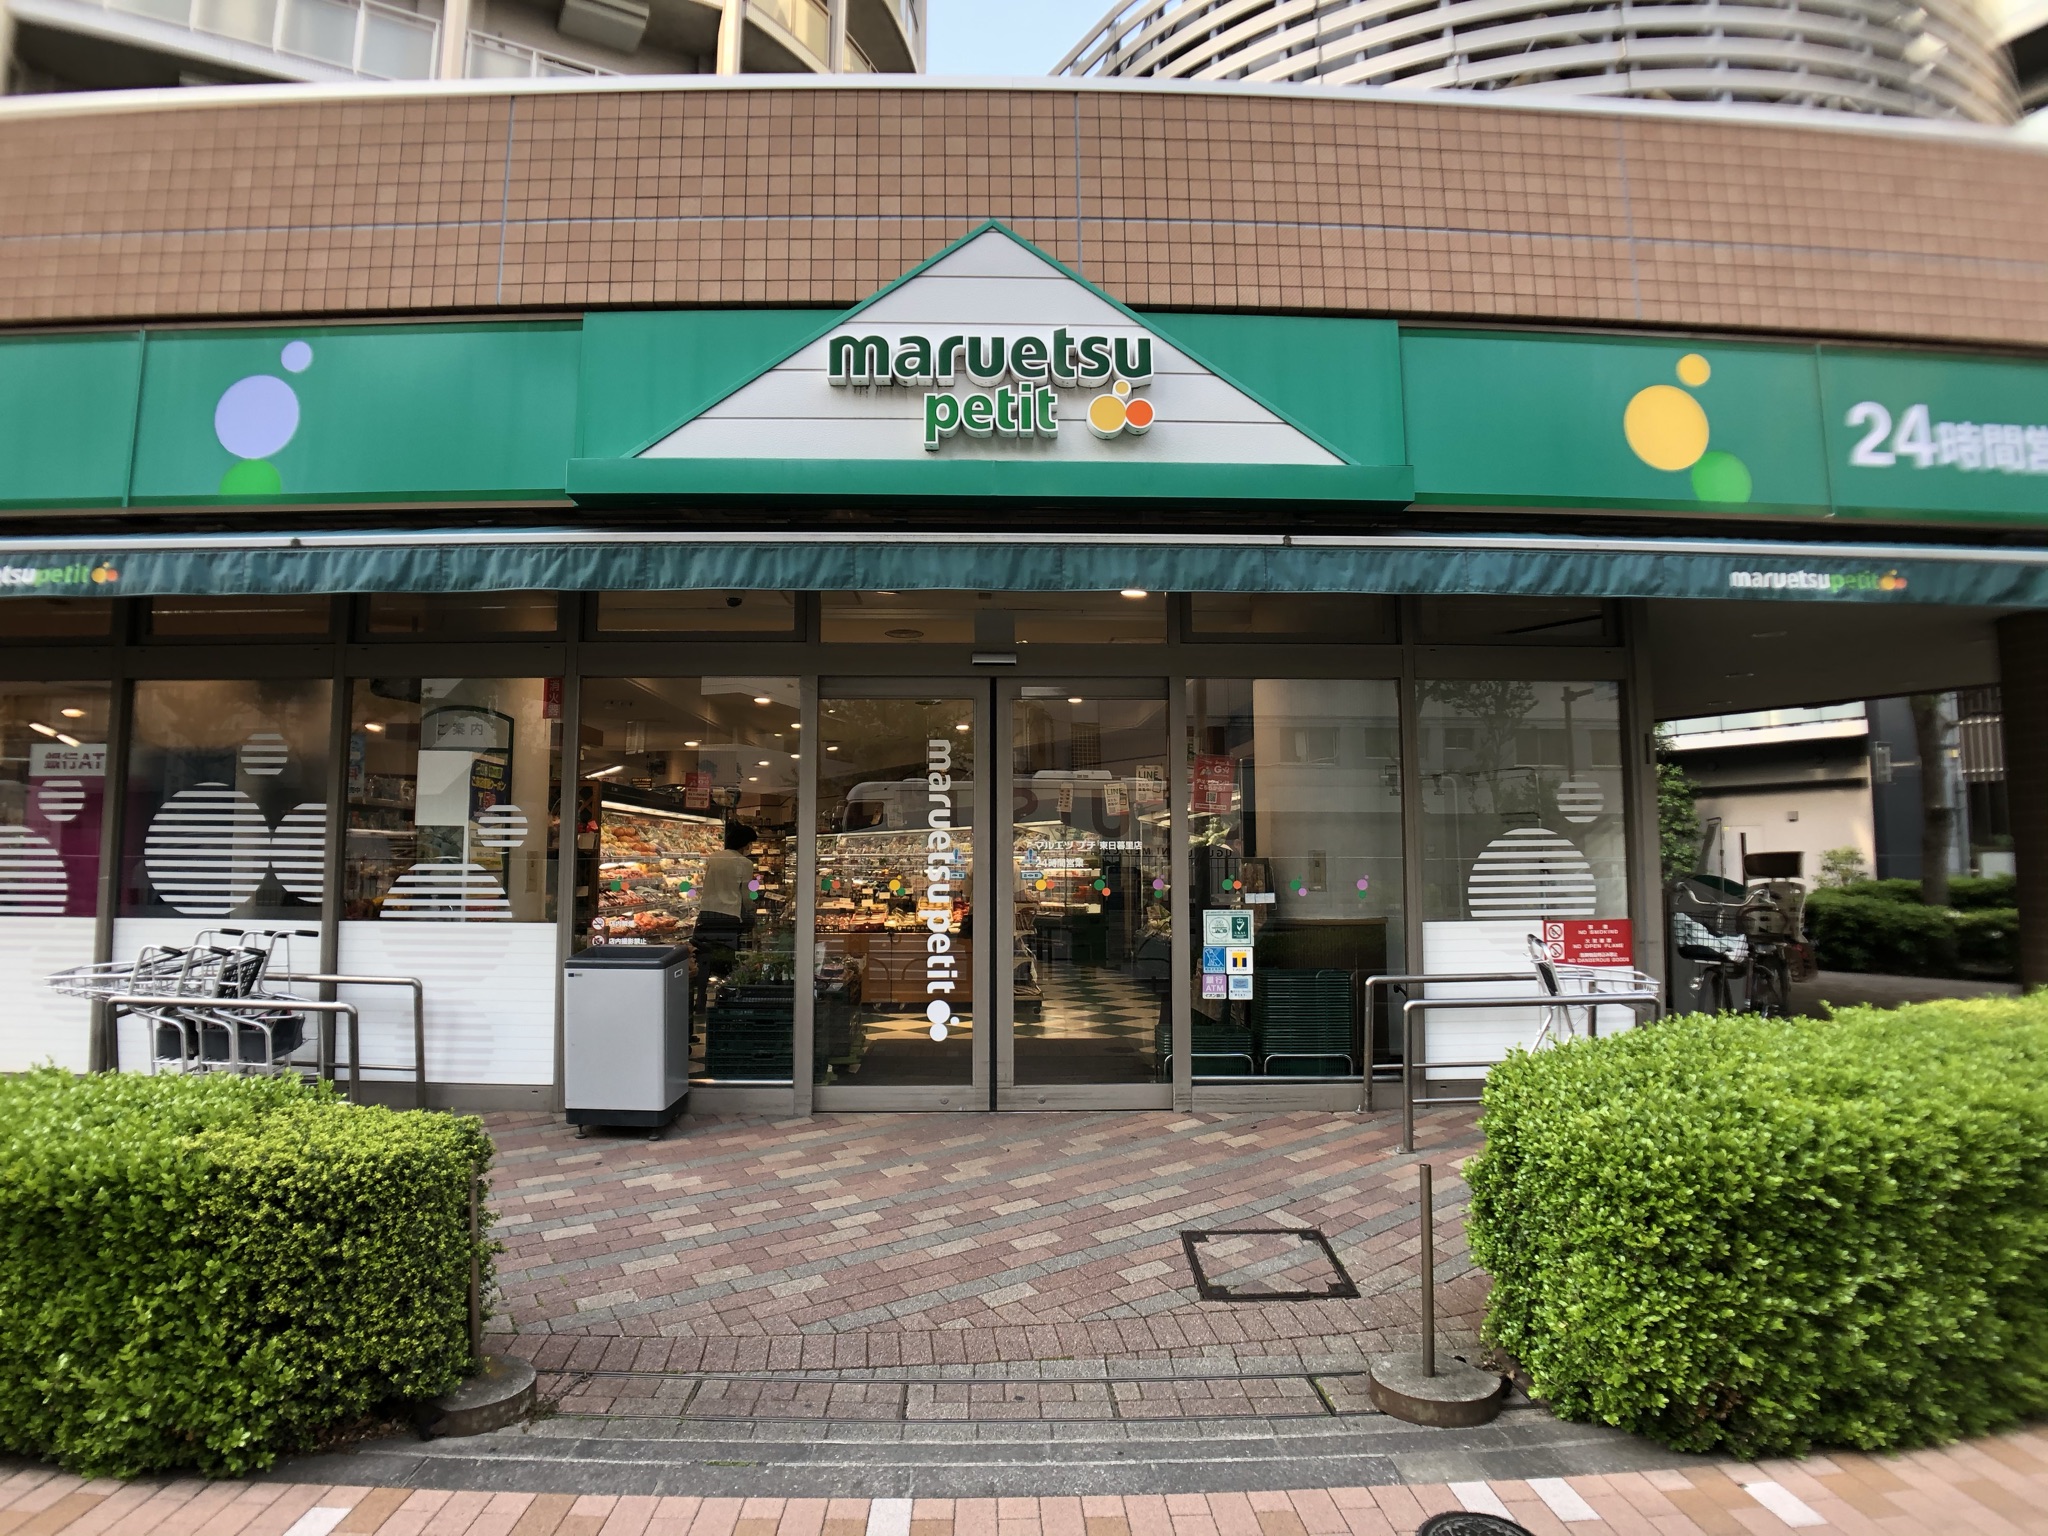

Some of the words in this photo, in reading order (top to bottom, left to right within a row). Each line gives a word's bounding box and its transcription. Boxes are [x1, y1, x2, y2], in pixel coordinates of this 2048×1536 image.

[827, 325, 1154, 386] maruetsu
[924, 381, 1058, 447] petit
[438, 722, 483, 736] ご案内
[1138, 771, 1158, 779] LINE
